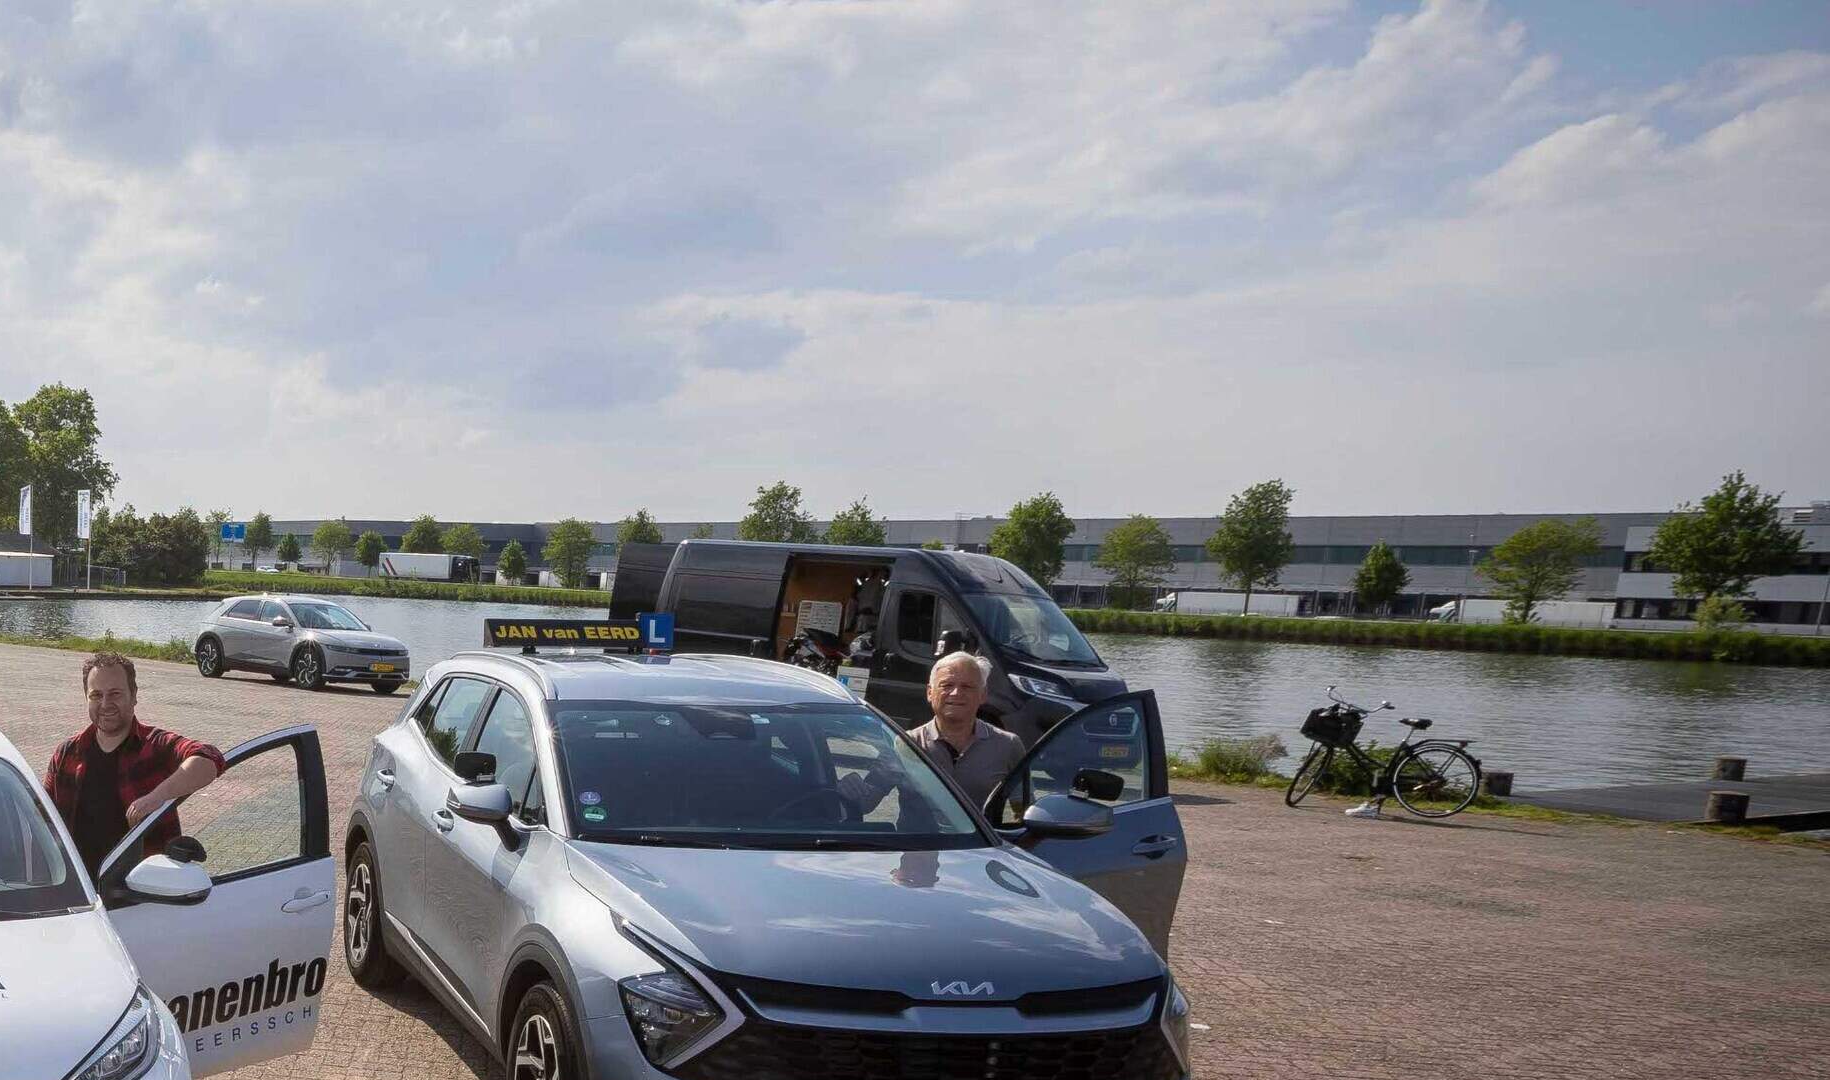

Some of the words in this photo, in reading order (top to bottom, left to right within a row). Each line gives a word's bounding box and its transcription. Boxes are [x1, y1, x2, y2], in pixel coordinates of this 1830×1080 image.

[495, 625, 537, 638] JAN
[542, 629, 579, 639] van
[583, 626, 640, 640] EERD
[649, 619, 666, 643] L
[165, 957, 328, 1034] anenbro
[195, 1005, 312, 1052] EERSSCH
